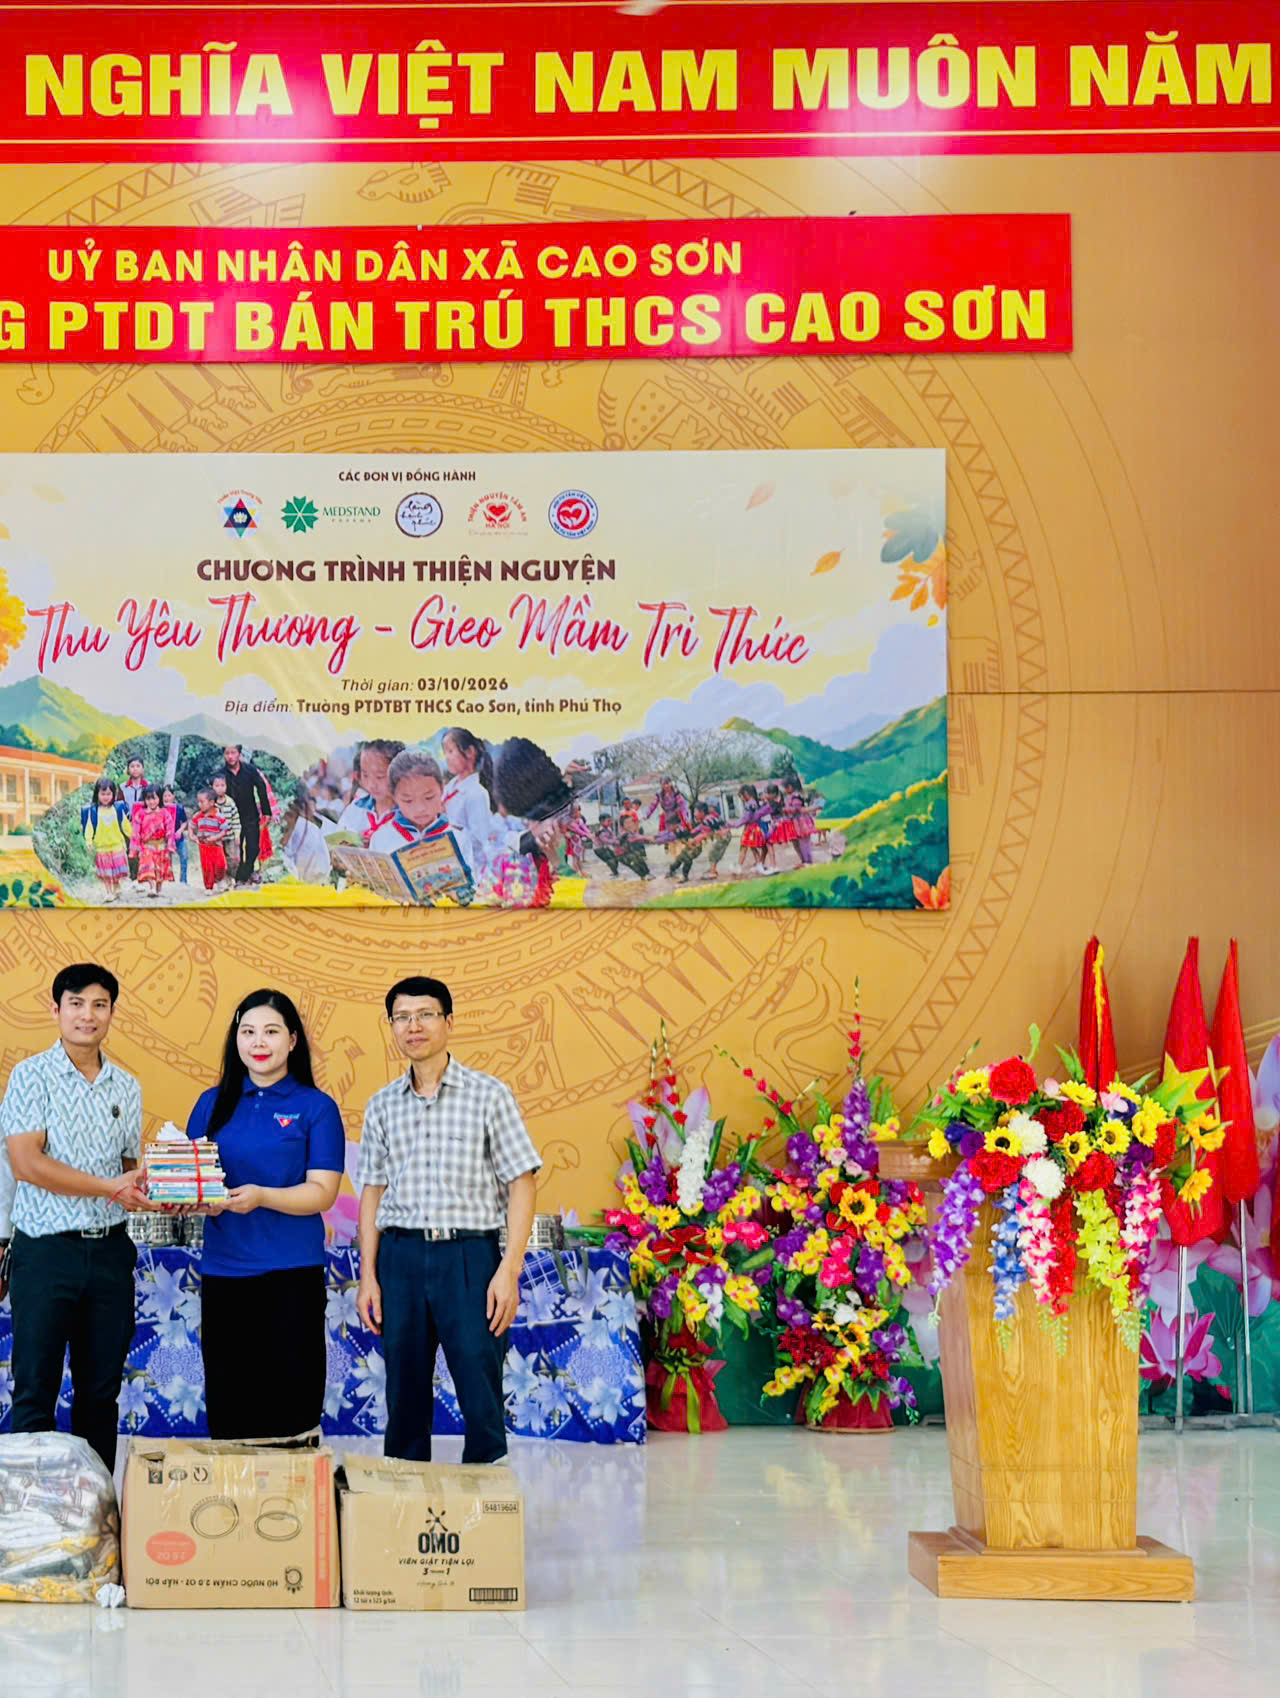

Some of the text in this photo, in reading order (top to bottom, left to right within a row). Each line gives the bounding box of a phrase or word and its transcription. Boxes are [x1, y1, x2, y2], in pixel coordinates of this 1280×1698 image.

[25, 40, 294, 116] NGHĨA
[323, 39, 505, 129] VIỆT
[535, 49, 738, 113] NAM
[772, 33, 1037, 111] MUÔN
[1069, 31, 1272, 106] NĂM
[48, 237, 741, 282] UỶ BAN NHÂN DÂN XÃ CAO SƠN
[49, 301, 215, 351] PTDT
[235, 290, 375, 351] BÁN
[394, 289, 524, 350] TRÚ
[544, 295, 722, 348] THCS
[745, 291, 881, 343] CAO
[903, 283, 1047, 342] SƠN
[338, 468, 361, 482] CÁC
[322, 506, 381, 517] MEDSTAND
[196, 553, 616, 586] CHƯƠNG TRÌNH THIỆN NGUYỆN
[27, 601, 111, 673] Thu
[118, 597, 202, 672] Yêu
[208, 592, 360, 674] Thương
[411, 594, 502, 650] Gieo
[508, 593, 629, 656] Mầm
[708, 604, 810, 673] Thức
[341, 676, 509, 694] Thời gian: 03/10/2026
[224, 699, 249, 715] Địa
[354, 699, 412, 714] PTDTBT
[414, 699, 453, 714] THCS
[456, 699, 485, 714] Cao
[559, 696, 589, 713] Phú
[417, 1531, 460, 1554] OMO
[422, 1567, 429, 1575] 3
